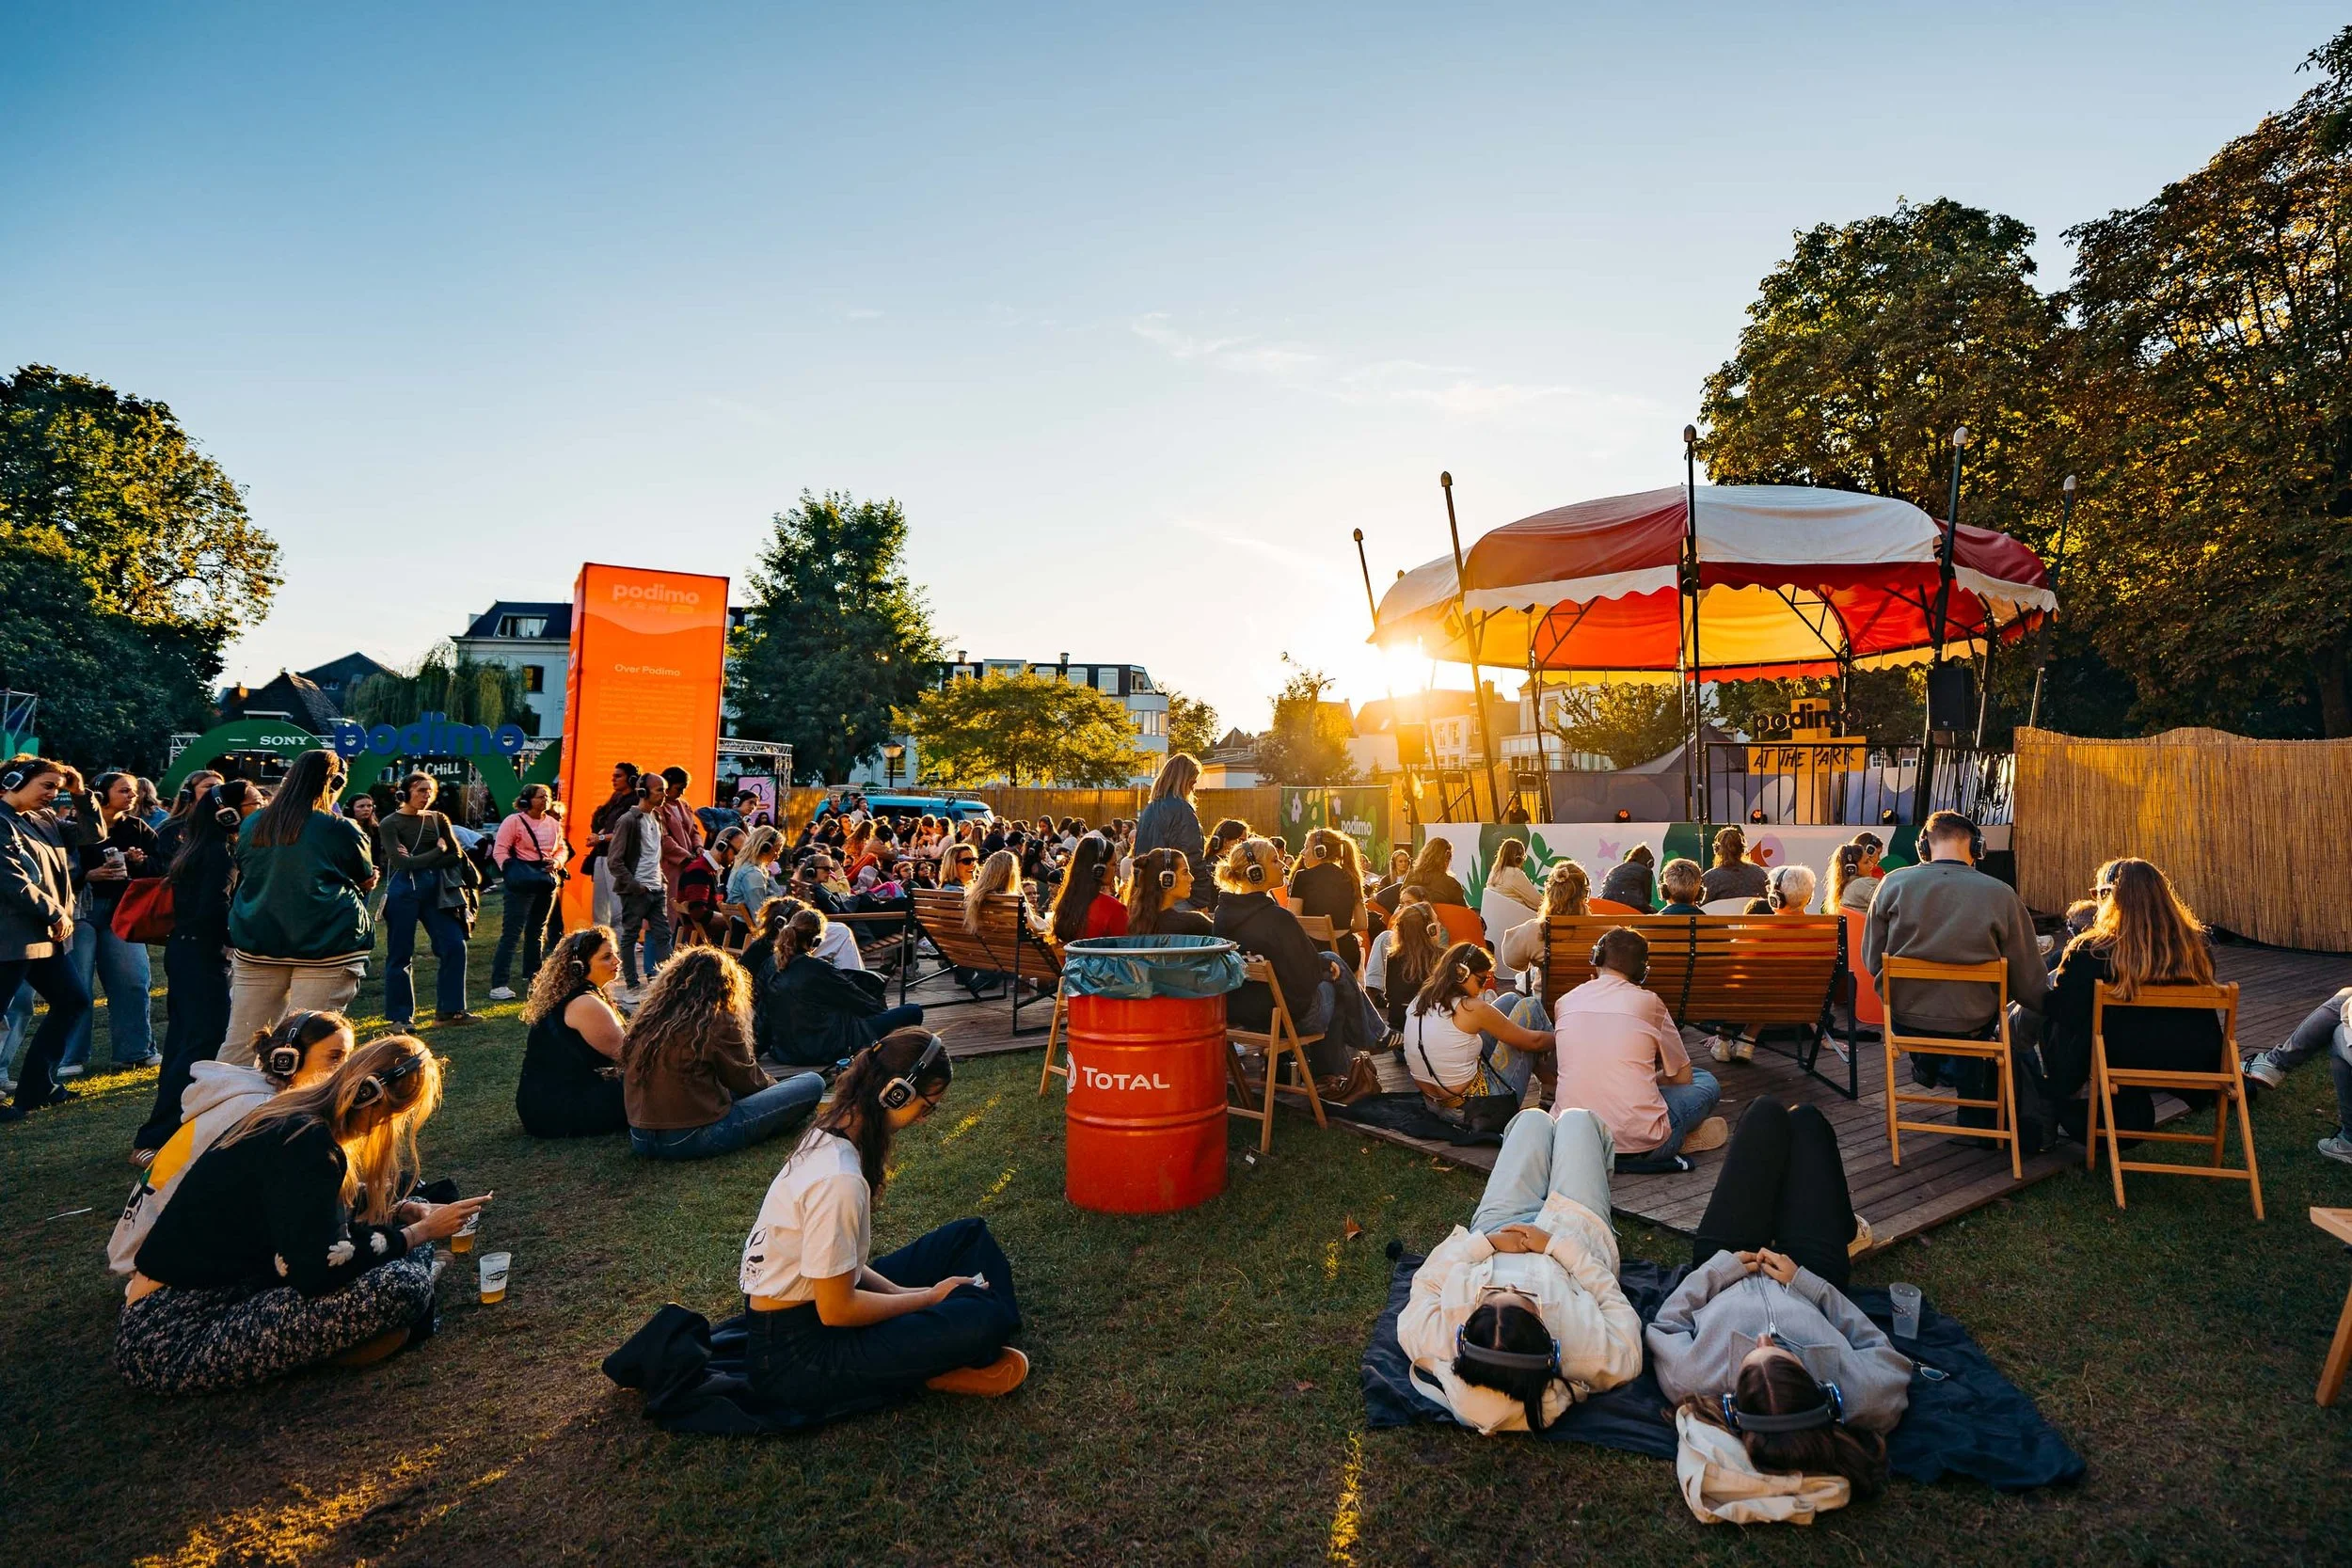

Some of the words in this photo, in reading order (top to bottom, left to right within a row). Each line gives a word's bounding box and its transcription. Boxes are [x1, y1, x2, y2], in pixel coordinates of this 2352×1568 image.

[612, 583, 700, 604] podimo
[614, 663, 641, 673] Over
[642, 665, 681, 677] Podimo
[260, 736, 310, 746] SONY
[335, 711, 525, 758] podimo
[1754, 749, 1776, 768] AT
[1780, 748, 1806, 768] THE
[1814, 746, 1855, 767] PARK
[1341, 815, 1373, 836] podimo
[1082, 1066, 1170, 1091] TOTAL
